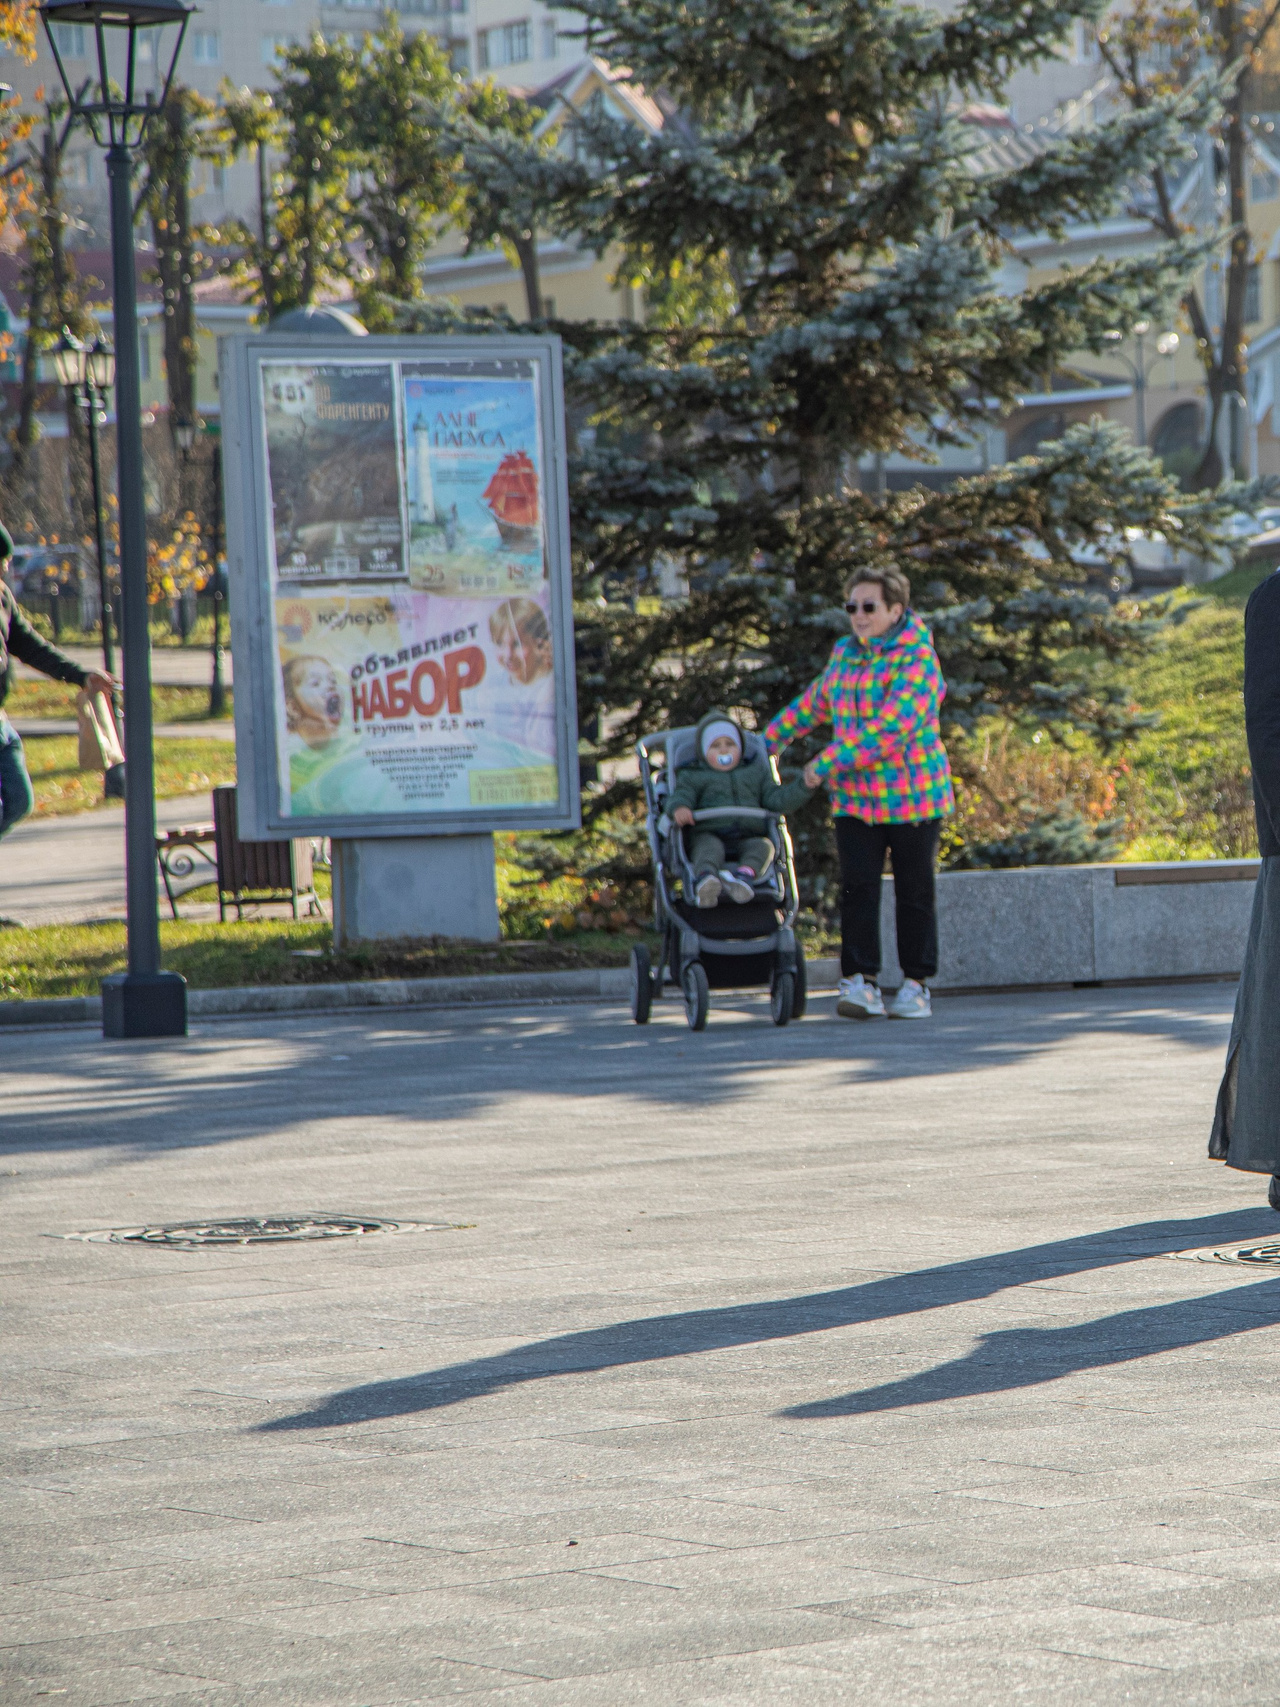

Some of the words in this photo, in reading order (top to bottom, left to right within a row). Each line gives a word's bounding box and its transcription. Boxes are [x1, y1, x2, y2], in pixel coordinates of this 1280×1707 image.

[350, 622, 479, 680] объявляет
[350, 644, 487, 724] НАБОР
[366, 722, 415, 737] группы
[420, 721, 434, 732] от
[440, 718, 460, 733] 2,5
[466, 719, 485, 730] лет
